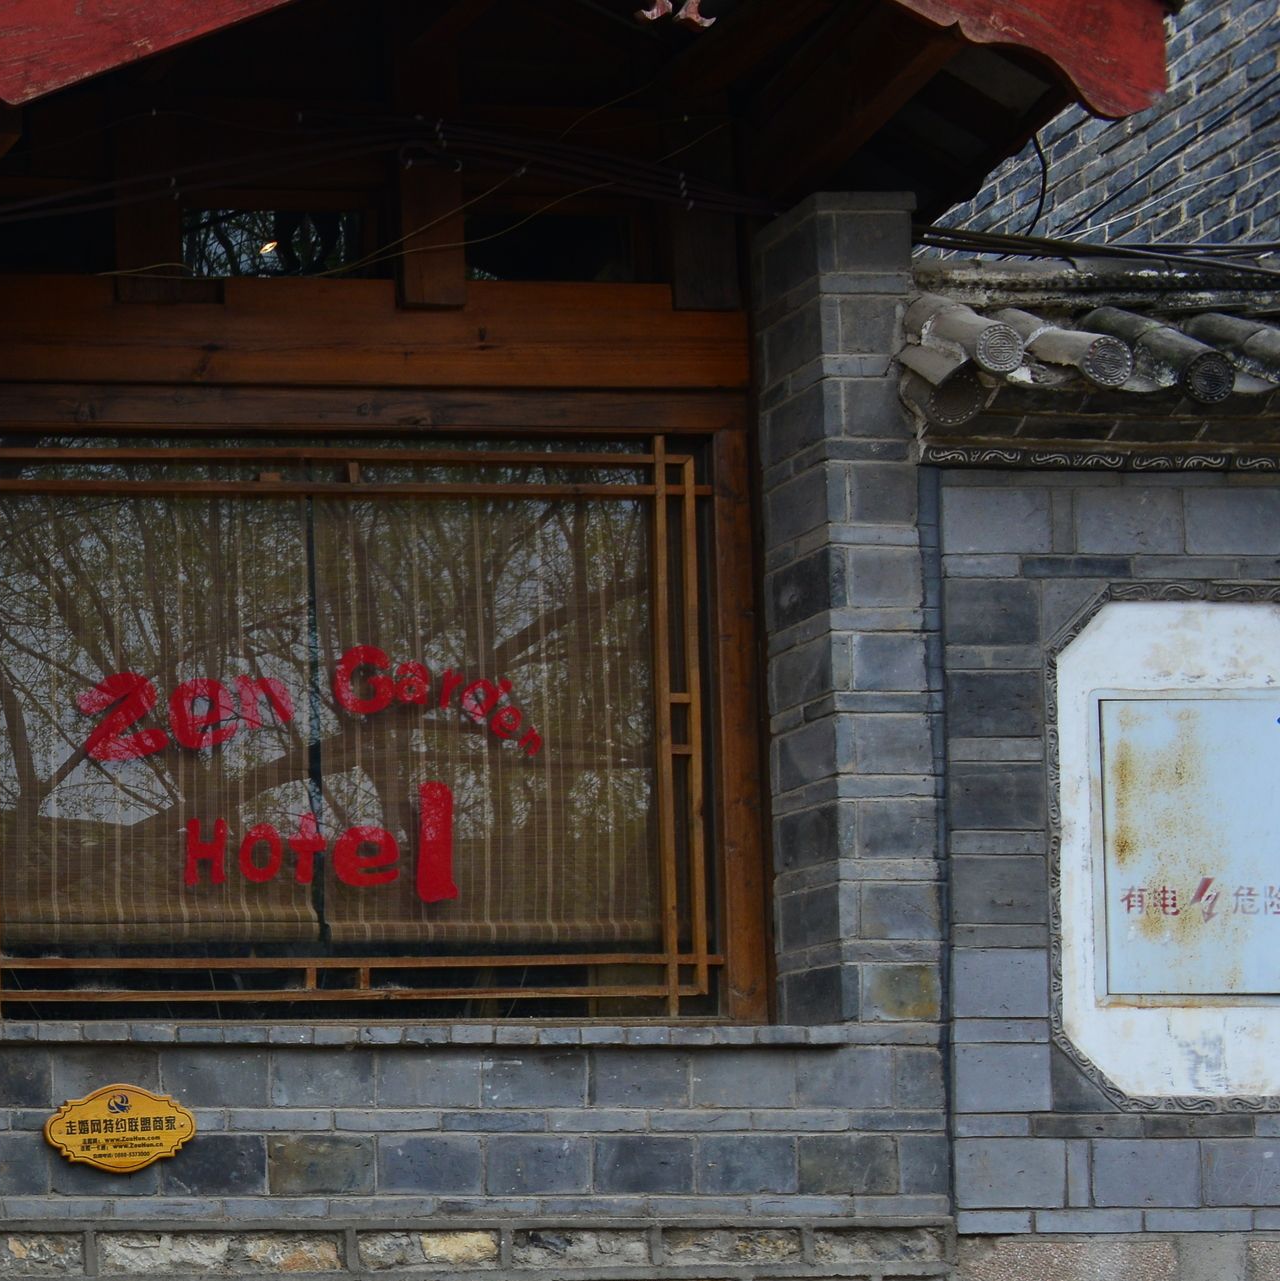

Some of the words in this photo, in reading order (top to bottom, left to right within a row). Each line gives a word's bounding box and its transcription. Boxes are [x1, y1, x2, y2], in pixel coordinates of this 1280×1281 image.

[75, 671, 296, 764] Zen
[333, 643, 544, 758] Garden
[1120, 885, 1180, 916] 有电
[66, 1116, 176, 1135] 走婚网特约联盟商家
